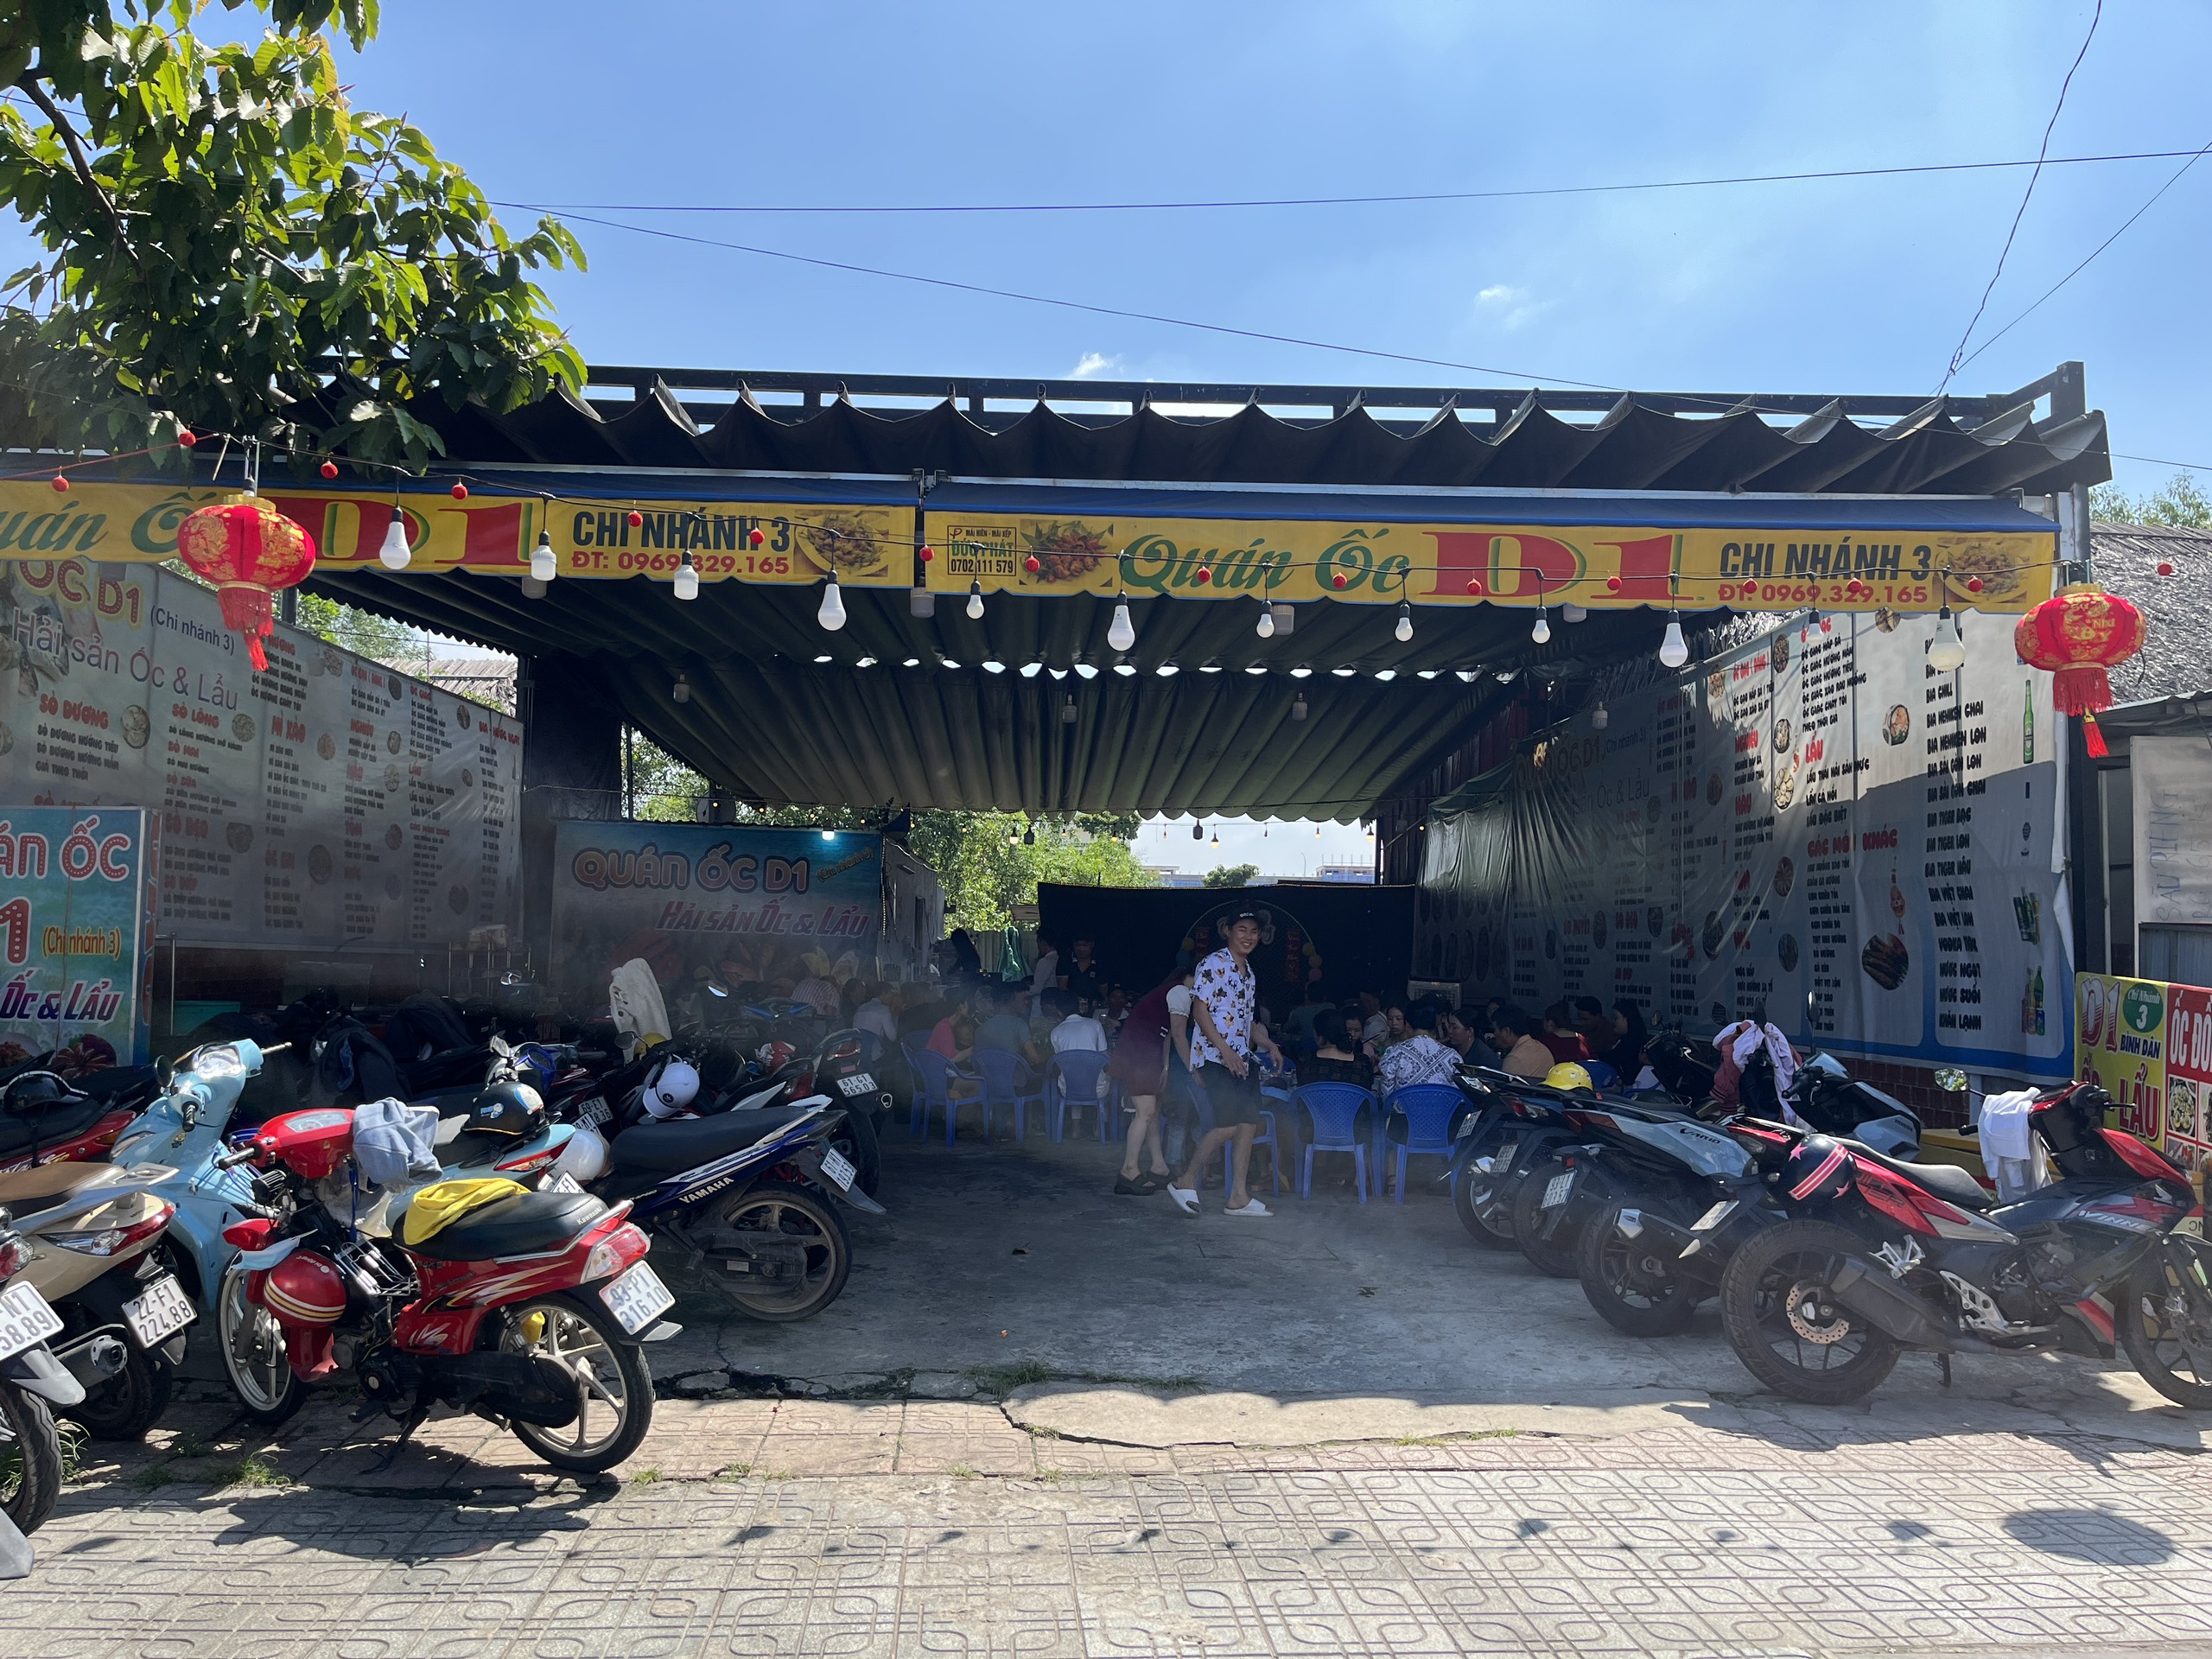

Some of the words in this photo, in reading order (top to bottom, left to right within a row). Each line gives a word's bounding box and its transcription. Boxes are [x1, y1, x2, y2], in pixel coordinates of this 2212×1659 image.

[0, 500, 108, 551] uán
[572, 511, 628, 548] CHI
[639, 506, 768, 550] NHÁNH
[770, 518, 791, 551] 3
[572, 551, 608, 569] ĐT:
[951, 559, 974, 572] 0702
[977, 560, 993, 572] 111
[996, 560, 1014, 573] 579
[1120, 533, 1297, 594] Quán
[1313, 528, 1408, 594] Ốc
[1421, 531, 1705, 602] D1
[1719, 543, 1773, 581] CHI
[1785, 536, 1899, 581] NHÁNH
[1911, 545, 1931, 581] 3
[98, 577, 140, 624] D1
[150, 606, 179, 632] (Chi
[181, 620, 219, 648] nhánh
[223, 633, 235, 655] 3)
[12, 608, 63, 658] Hải
[71, 634, 119, 675] sản
[130, 646, 166, 689] Ốc
[173, 666, 189, 696] &
[198, 672, 238, 710] Lẩu
[1926, 688, 1936, 703] BIA
[1927, 713, 1936, 728] BIA
[1927, 737, 1938, 754] BIA
[1970, 727, 1986, 745] LON
[1927, 763, 1937, 779] BIA
[1967, 753, 1981, 770] LON
[1927, 787, 1937, 803] BIA
[1927, 813, 1937, 828] BIA
[60, 817, 130, 880] ỐC
[1926, 837, 1936, 853] BIA
[1938, 836, 1955, 851] TIGER
[1956, 834, 1970, 849] LON
[574, 845, 689, 889] QUÁN
[698, 843, 758, 890] ỐC
[765, 857, 810, 892] D1
[1925, 862, 1936, 878] BIA
[1937, 861, 1955, 876] TIGER
[794, 914, 814, 933] &
[69, 927, 105, 954] nhánh
[108, 928, 120, 958] 3)
[1938, 938, 1962, 952] VODKA
[37, 992, 61, 1020] &
[2081, 976, 2120, 1052] D1
[2136, 1005, 2148, 1029] 3
[2120, 1030, 2139, 1054] BÌNH
[2141, 1036, 2160, 1059] DÂN
[2171, 989, 2188, 1066] ỐC
[2191, 994, 2212, 1072] ĐỒ
[2120, 1062, 2160, 1141] LẨU
[678, 1177, 734, 1204] YAMAHA
[576, 1205, 603, 1225] Kawasaki
[133, 1283, 176, 1320] 22-F1
[611, 1268, 654, 1307] 93-P1
[139, 1300, 192, 1344] 224.88
[618, 1286, 669, 1329] 316.10
